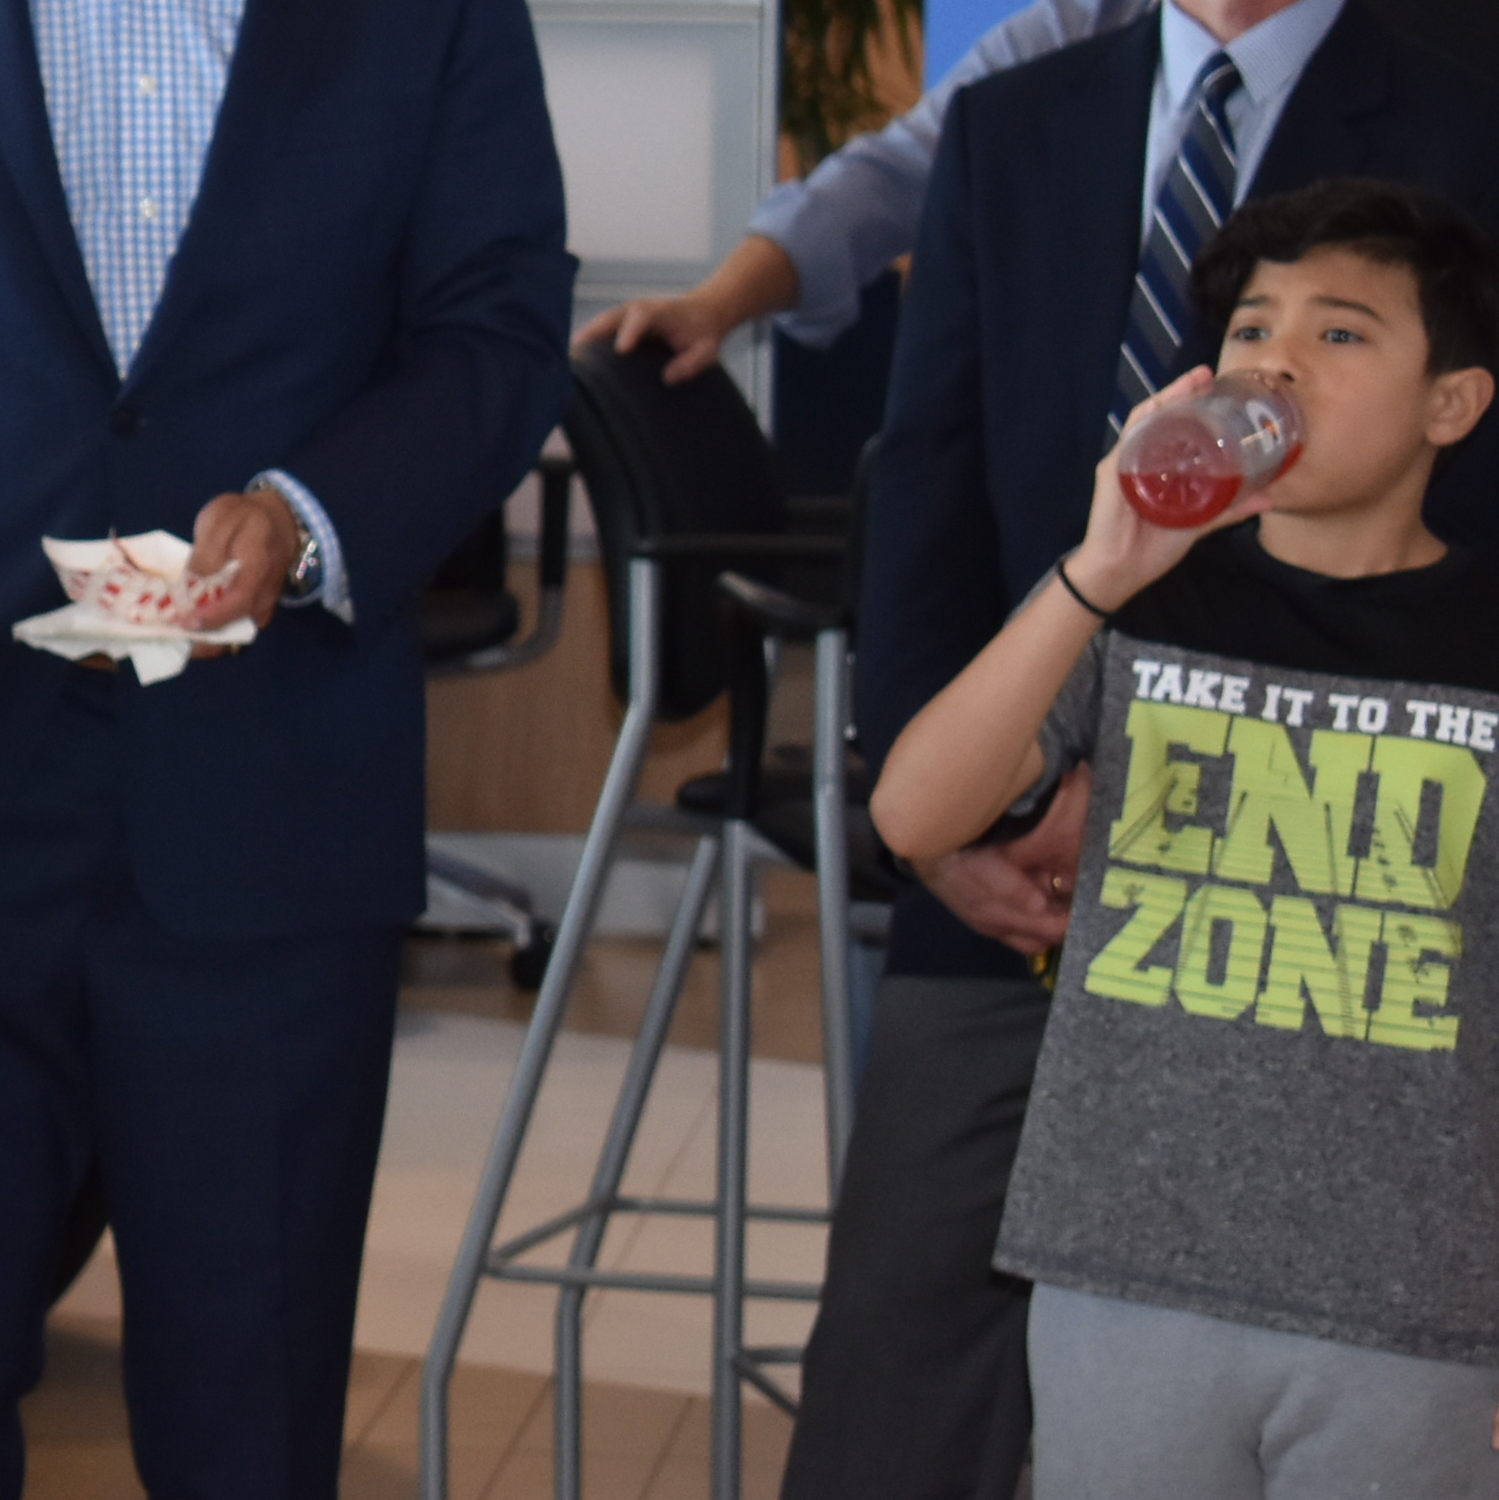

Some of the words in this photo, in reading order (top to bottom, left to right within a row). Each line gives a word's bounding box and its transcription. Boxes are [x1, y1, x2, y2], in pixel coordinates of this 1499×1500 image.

[1132, 658, 1252, 715] TAKE
[1261, 683, 1314, 728] IT
[1328, 694, 1390, 736] TO
[1405, 700, 1498, 752] THE
[1108, 699, 1488, 911] END
[1084, 866, 1464, 1051] ZONE
